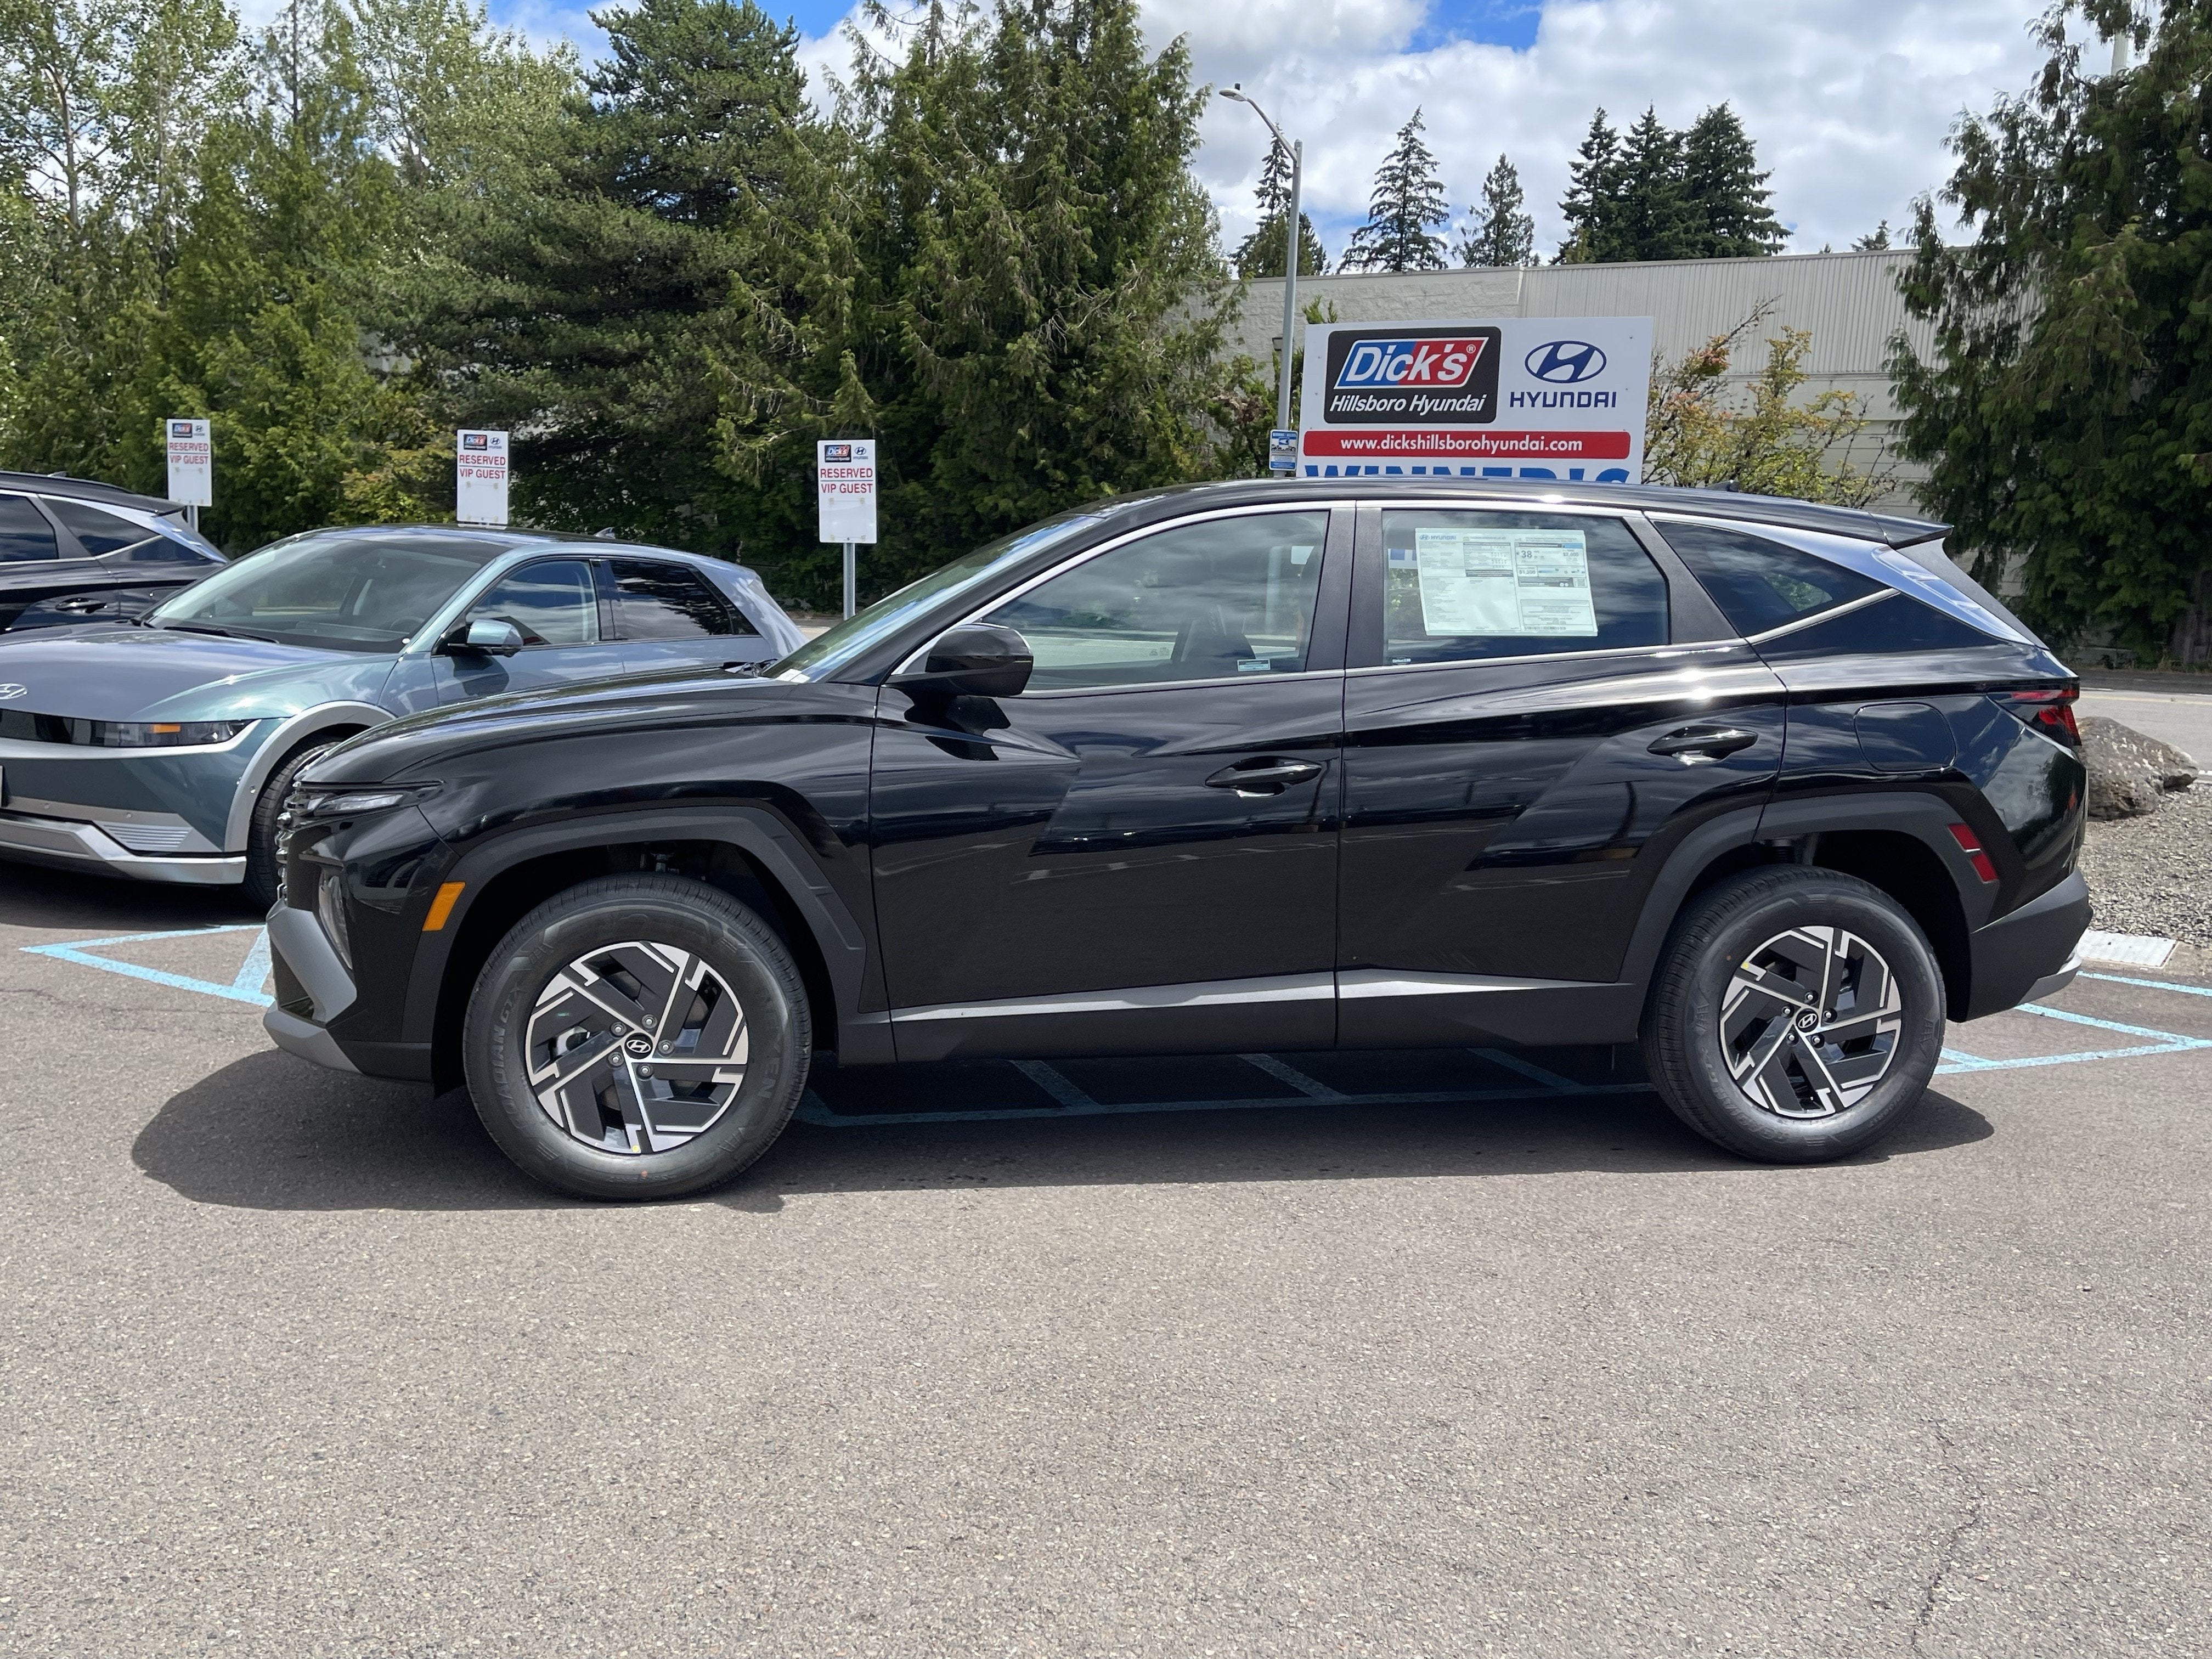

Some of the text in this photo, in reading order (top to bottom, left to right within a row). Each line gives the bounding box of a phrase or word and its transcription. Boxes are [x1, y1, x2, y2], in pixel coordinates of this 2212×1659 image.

[1510, 391, 1616, 408] HYUNDAI
[1329, 394, 1487, 416] Hillsboro Hyundai
[168, 442, 208, 452] RESERVED
[1340, 435, 1583, 455] www.dickshillsborohyundai.com
[169, 455, 208, 464] VIP GUEST
[459, 454, 506, 465] RESERVED
[459, 469, 506, 479] VIP GUEST
[820, 468, 873, 478] RESERVED
[821, 483, 873, 494] VIP GUEST
[1521, 550, 1533, 558] 38
